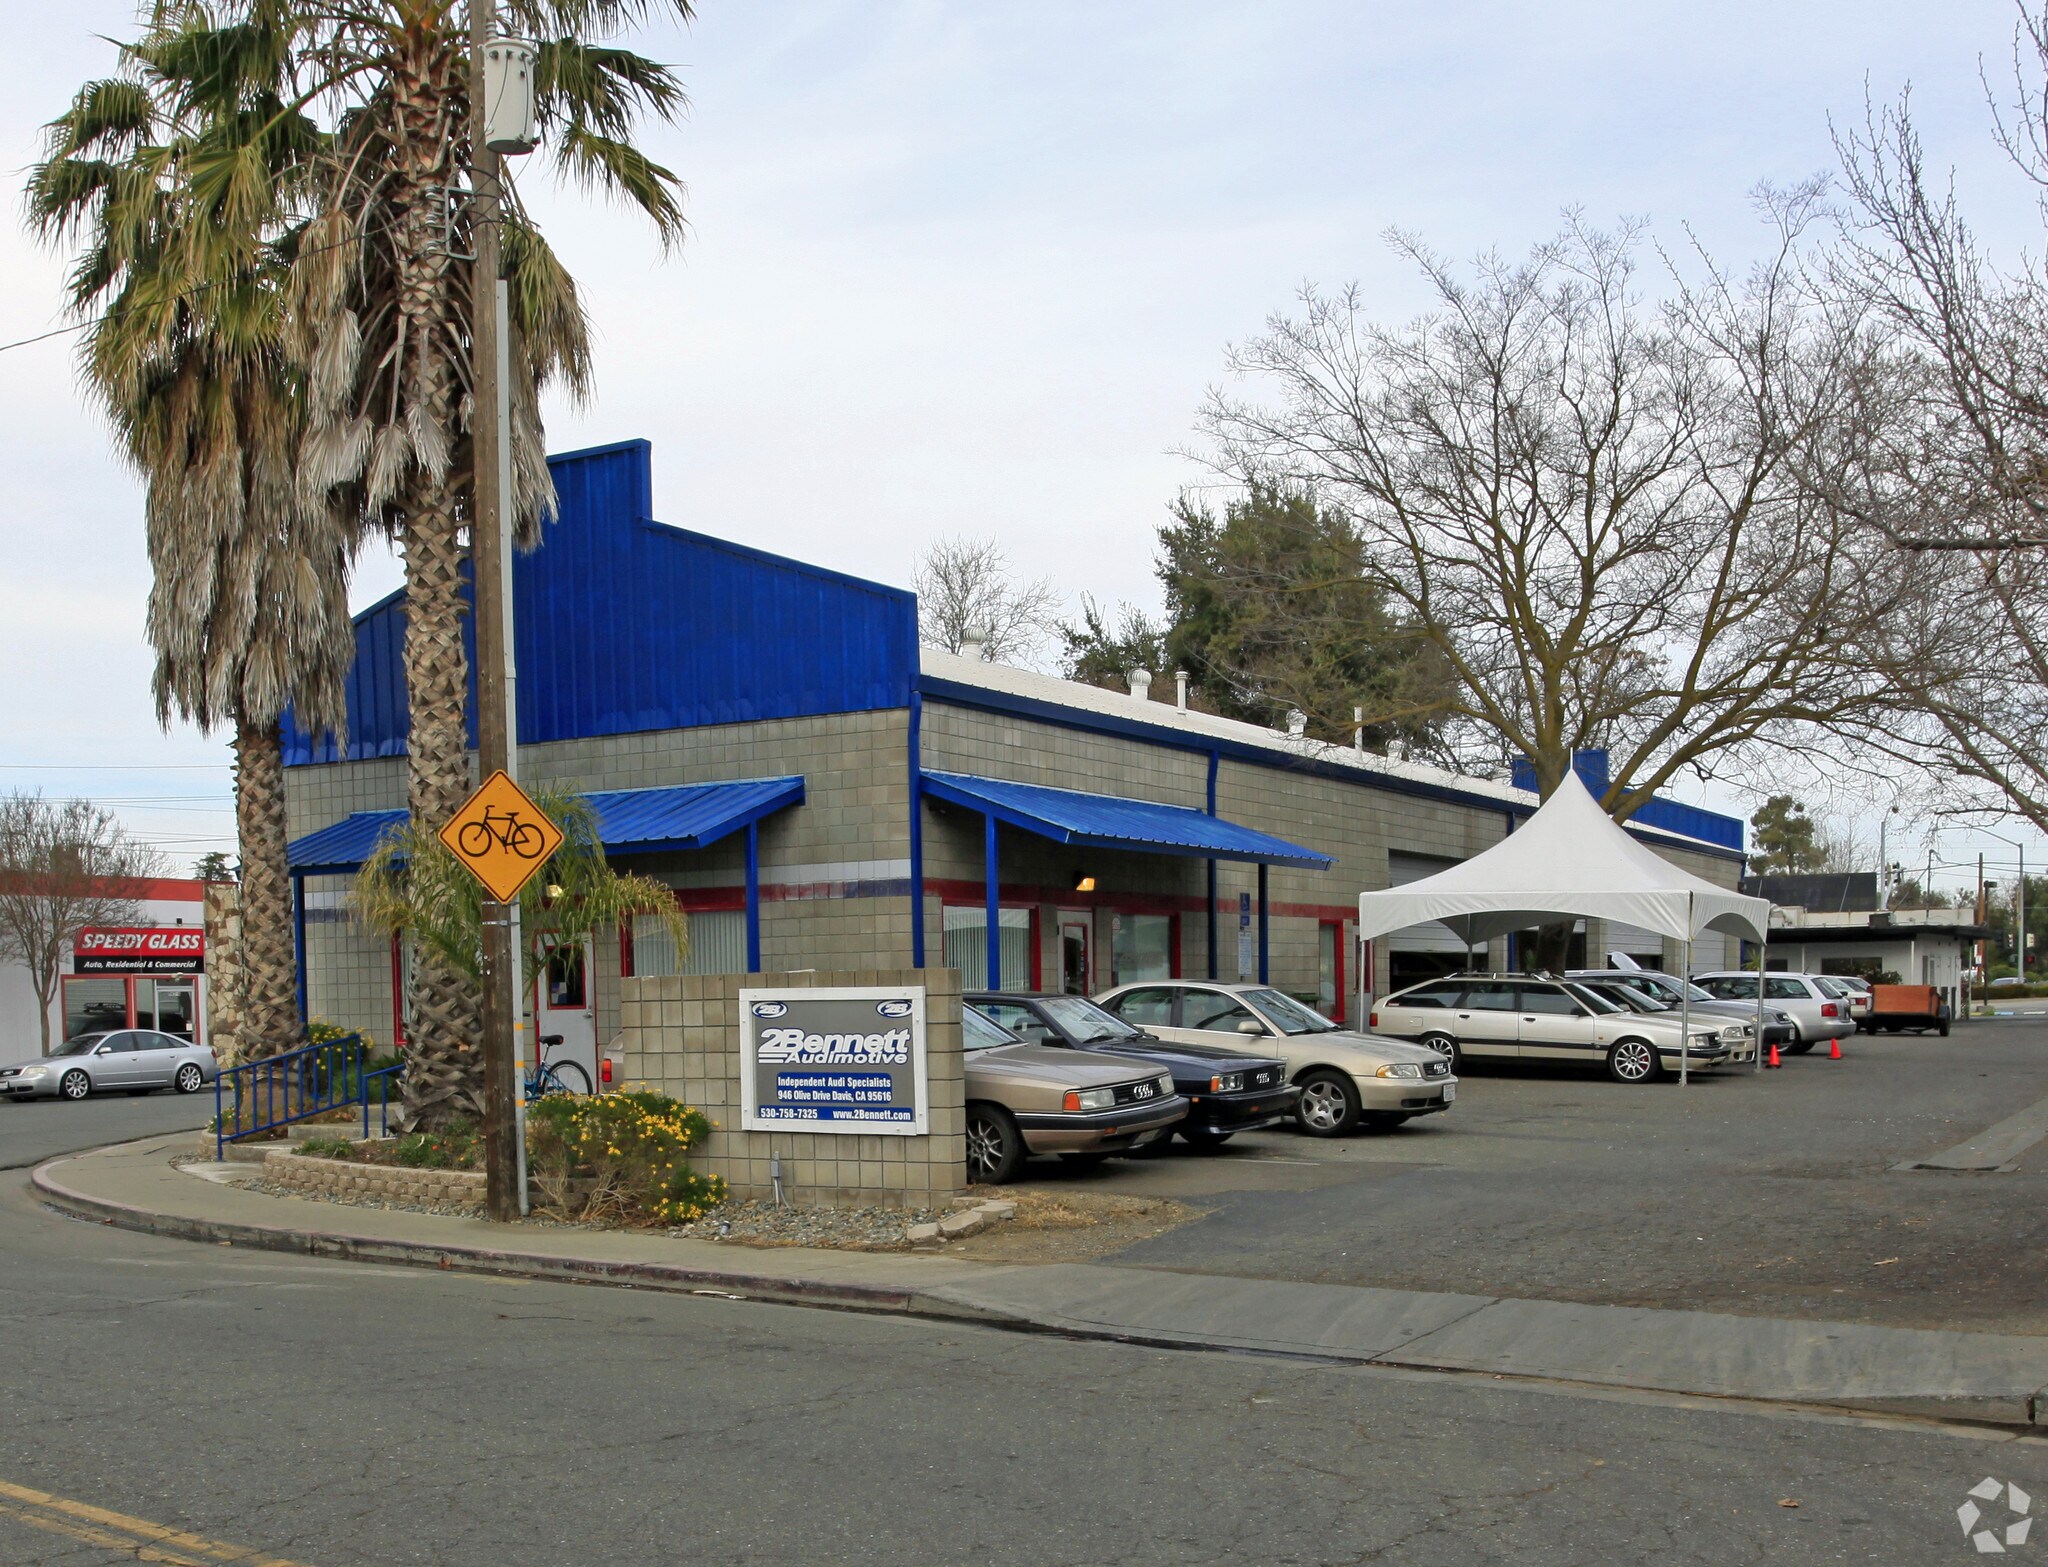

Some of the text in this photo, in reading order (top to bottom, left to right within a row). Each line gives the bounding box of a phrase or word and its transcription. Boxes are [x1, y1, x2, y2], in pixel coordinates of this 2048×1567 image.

[82, 934, 200, 949] SPEEDY GLASS
[84, 961, 104, 969] Auto,
[758, 1028, 911, 1053] 2Bennett
[784, 1051, 909, 1065] Audimotive
[778, 1076, 891, 1088] Independent Audi Specialists
[778, 1091, 891, 1102] 946 Olive Drive Davis, CA 95616
[761, 1108, 911, 1120] 530-758-7325 www.2Bennett.com
